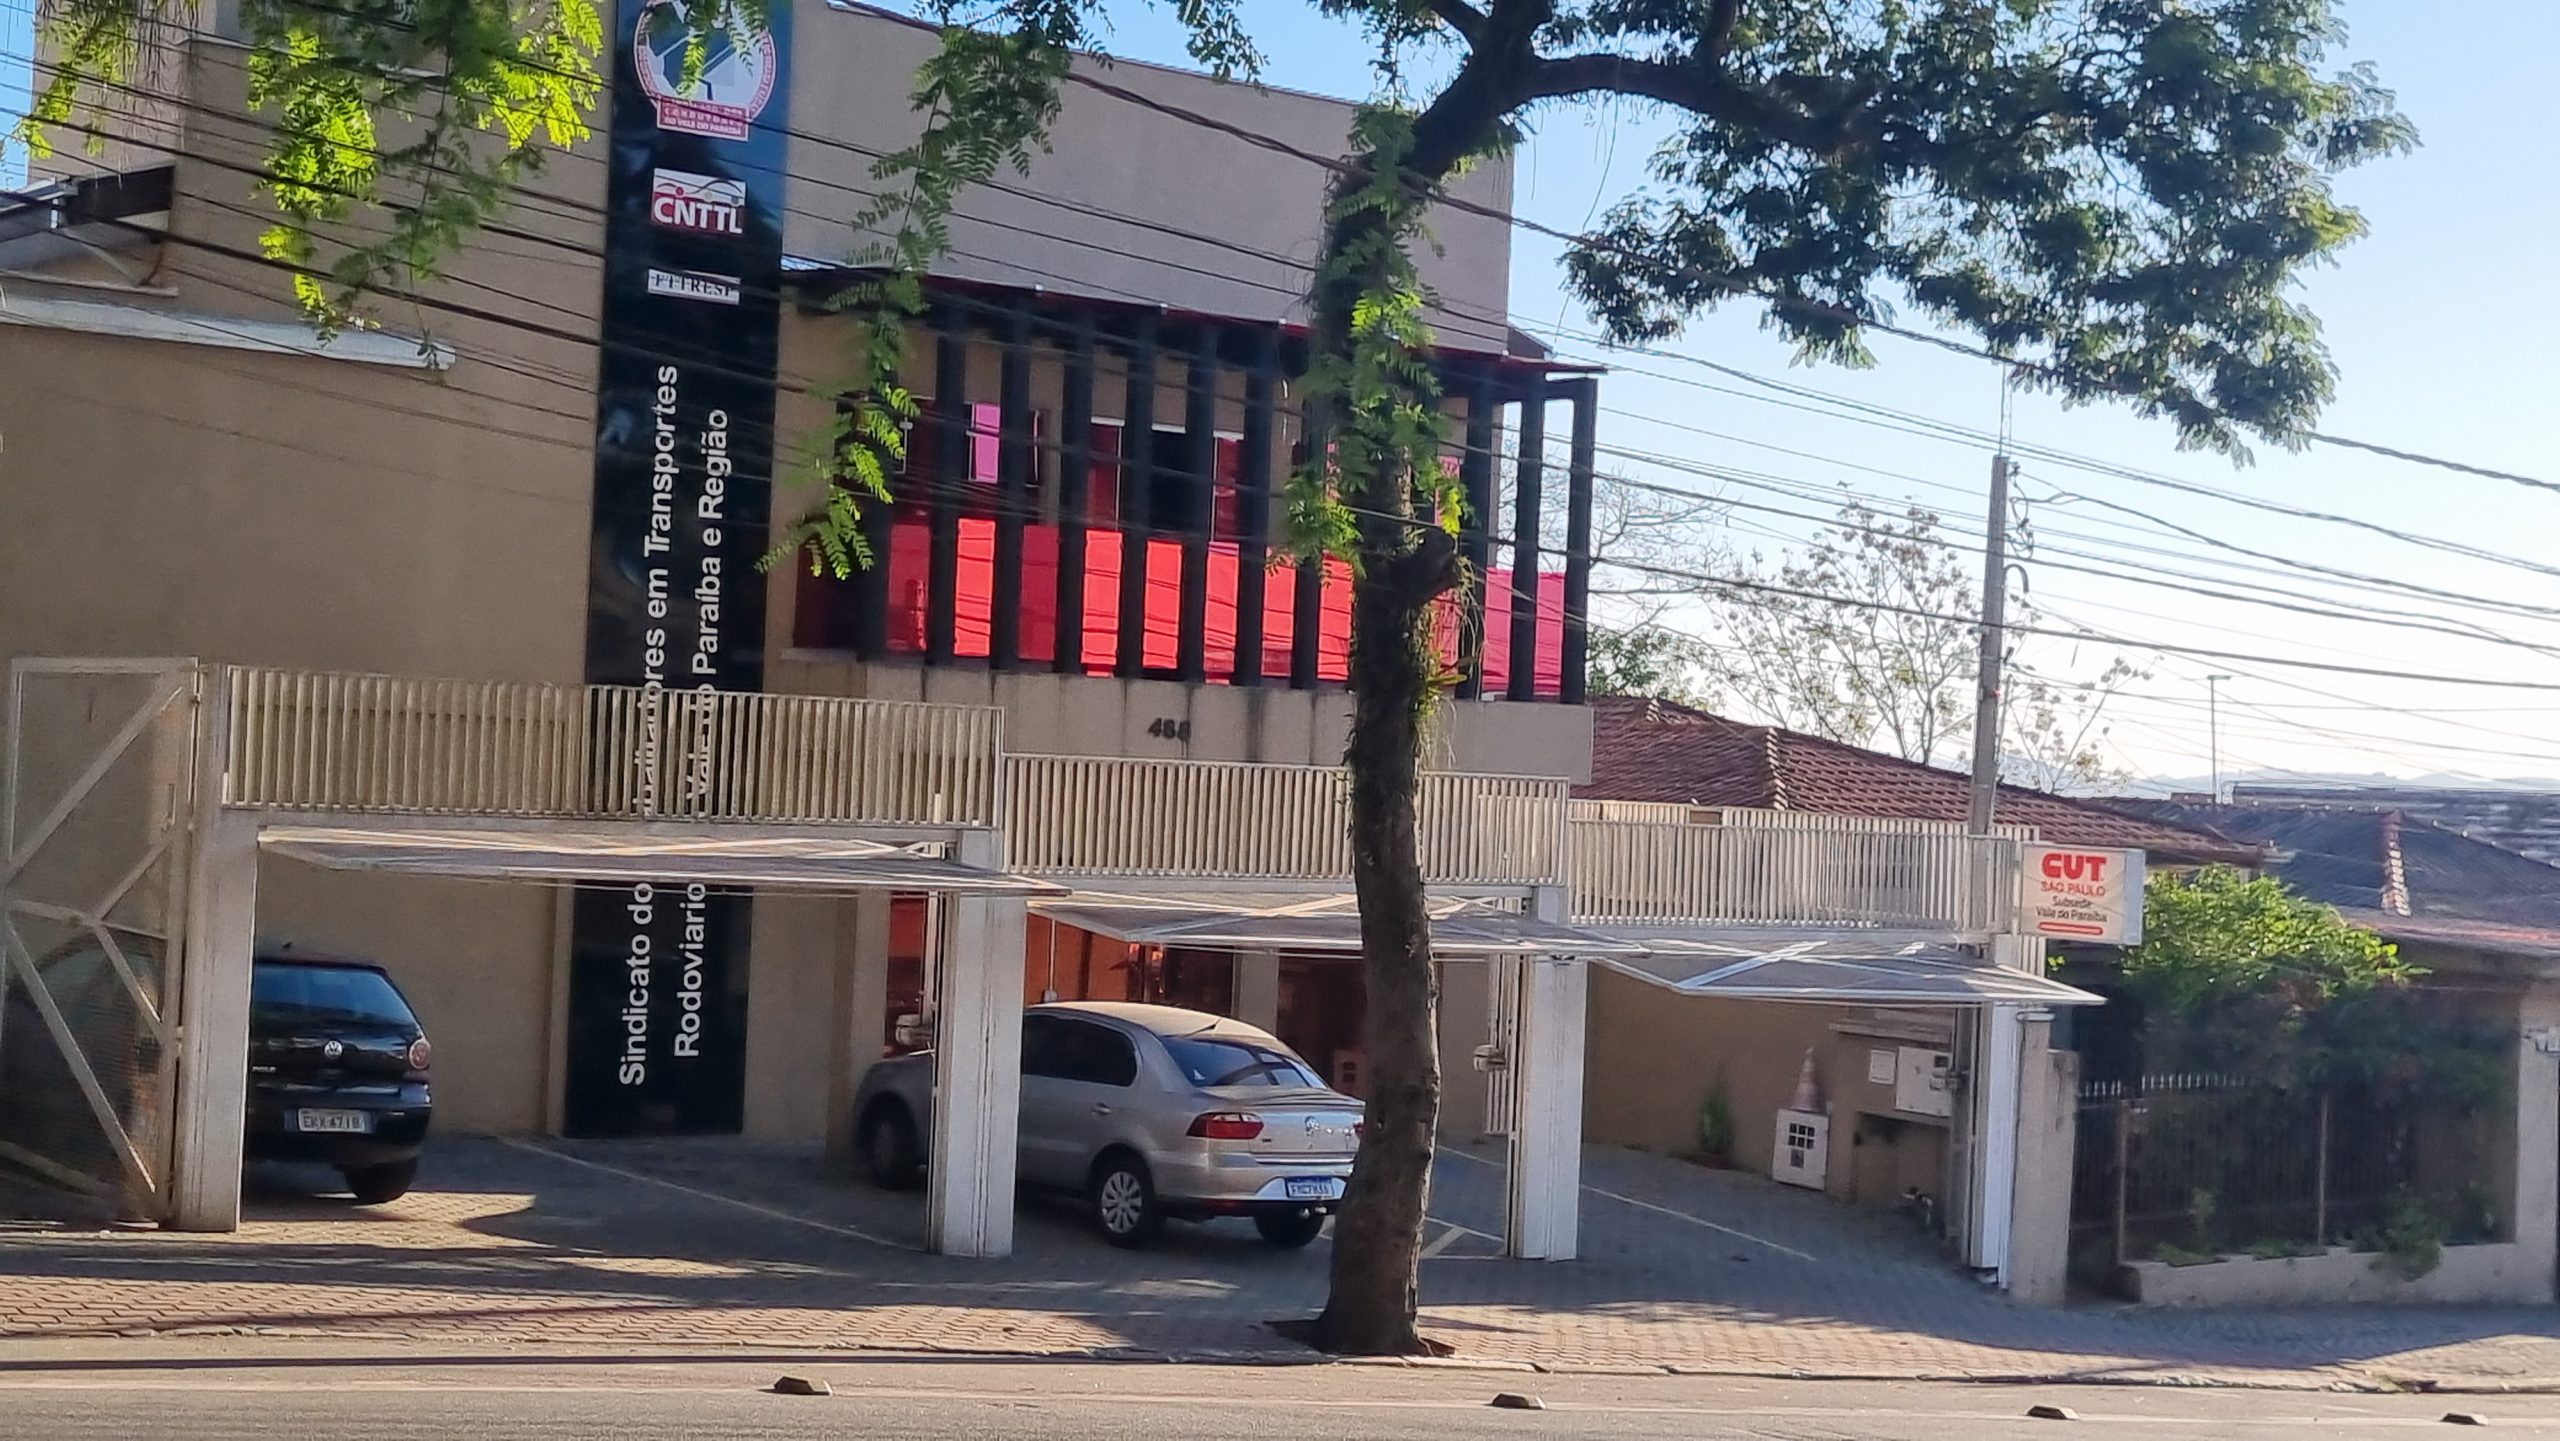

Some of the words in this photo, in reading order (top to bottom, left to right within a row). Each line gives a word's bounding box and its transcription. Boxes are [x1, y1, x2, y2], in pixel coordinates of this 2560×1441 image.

[653, 197, 742, 234] CNTTL
[644, 365, 680, 557] Transportes
[698, 409, 732, 519] Região
[702, 528, 722, 547] e
[648, 568, 669, 619] em
[692, 556, 722, 675] Paraíba
[2042, 853, 2107, 882] CUT
[2067, 883, 2107, 897] PAULO
[619, 935, 651, 1086] Sindicato
